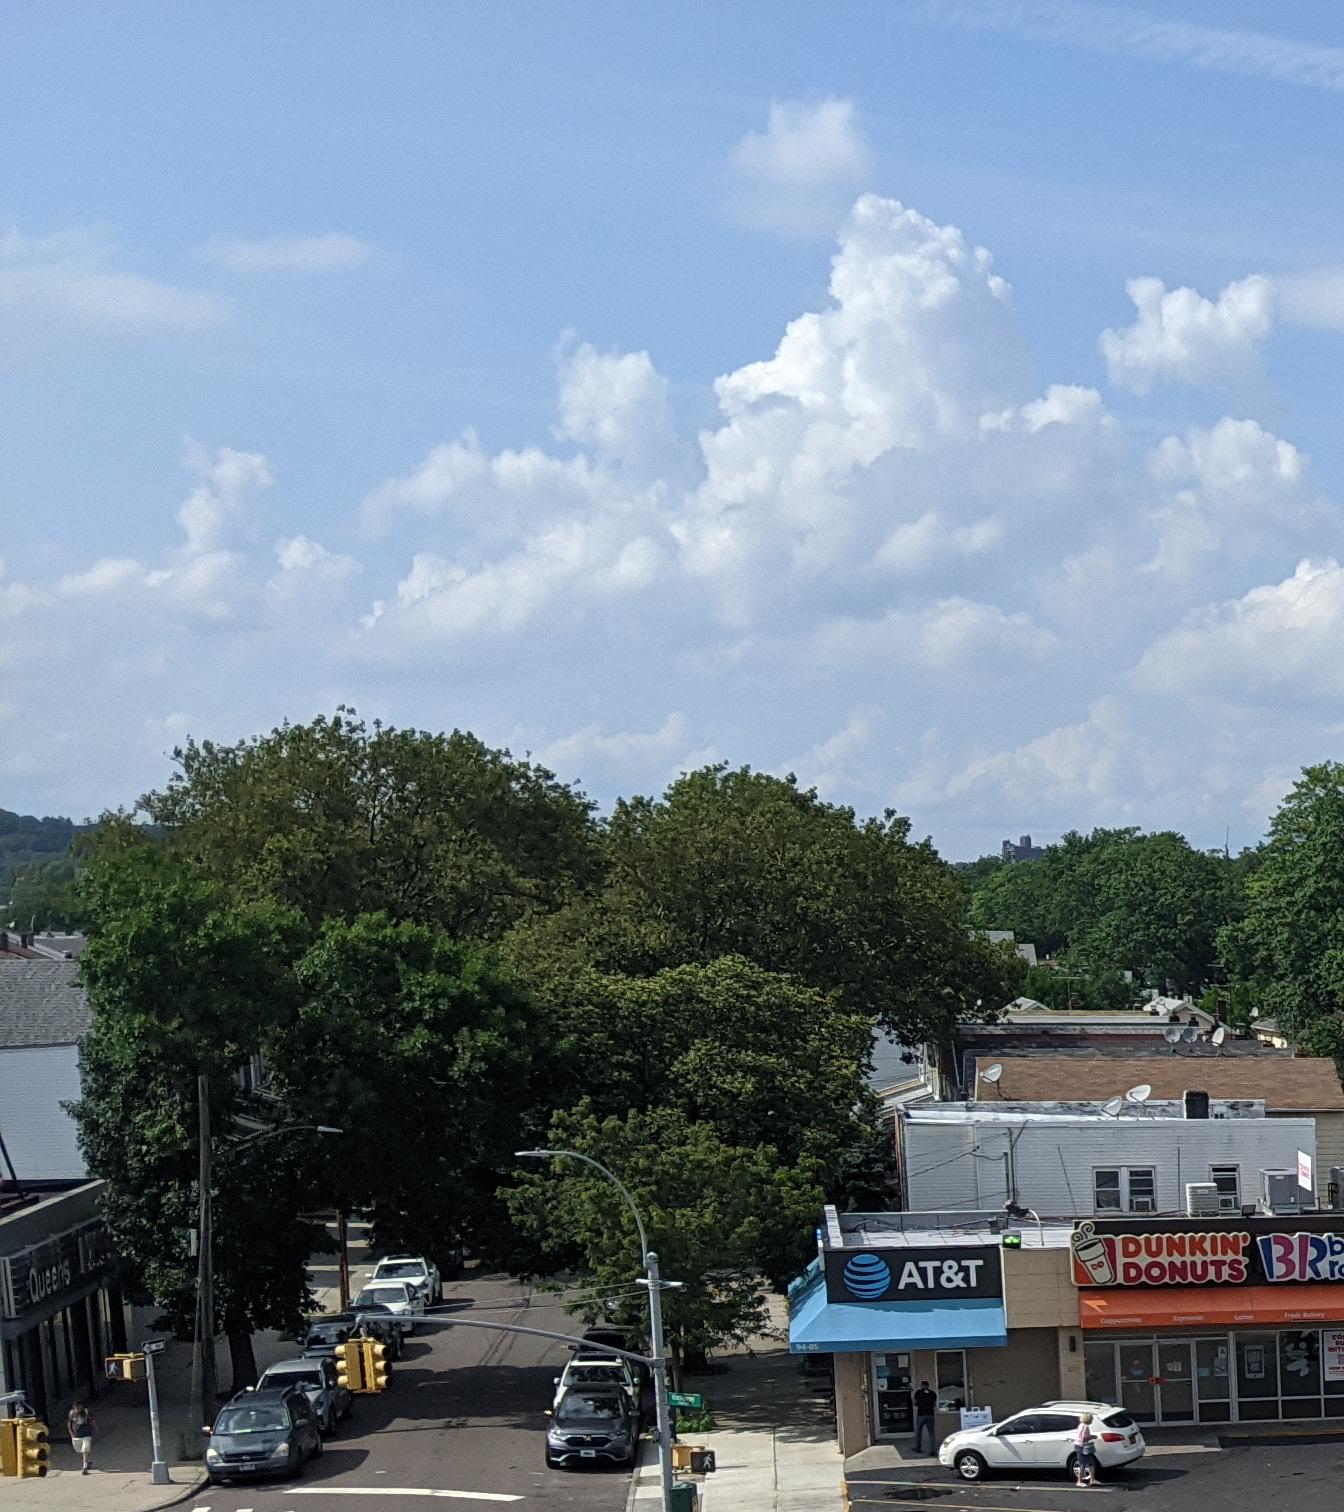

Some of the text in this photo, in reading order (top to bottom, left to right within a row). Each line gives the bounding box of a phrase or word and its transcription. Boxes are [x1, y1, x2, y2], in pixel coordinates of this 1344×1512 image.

[1122, 1233, 1249, 1258] DUNKIN'
[1260, 1234, 1328, 1280] BR
[898, 1259, 984, 1290] AT&T
[1123, 1258, 1245, 1284] DONUTS
